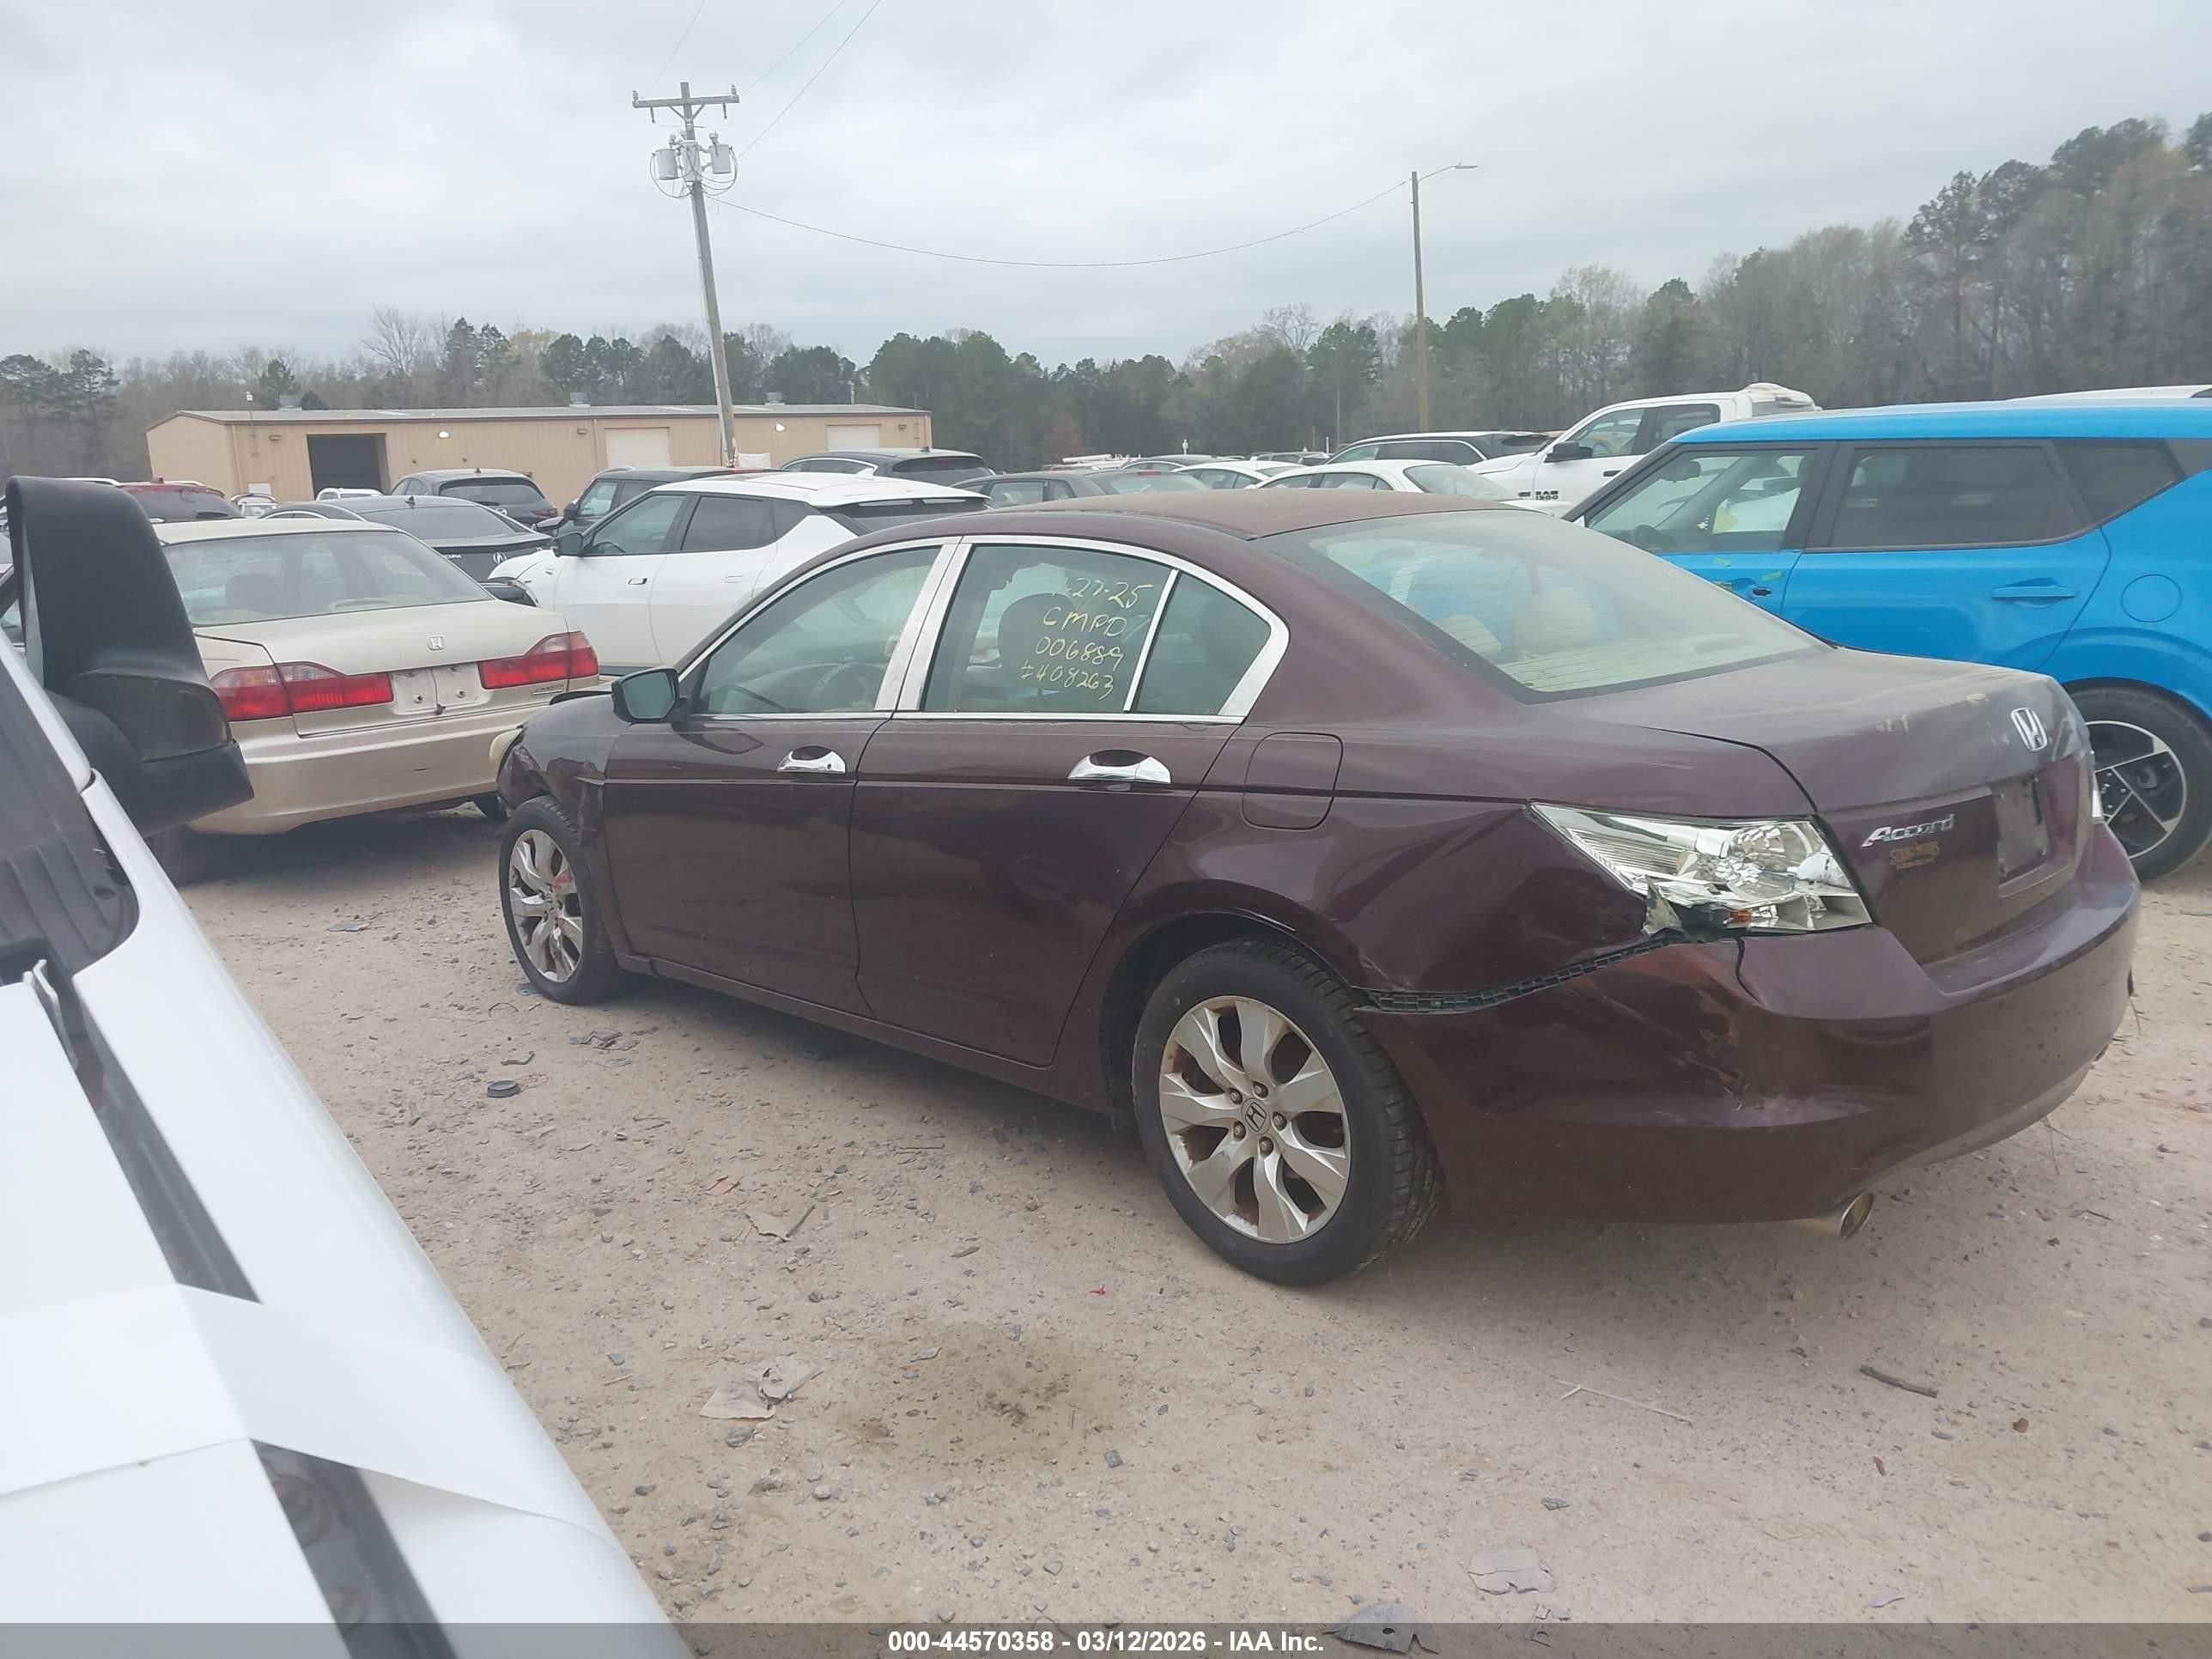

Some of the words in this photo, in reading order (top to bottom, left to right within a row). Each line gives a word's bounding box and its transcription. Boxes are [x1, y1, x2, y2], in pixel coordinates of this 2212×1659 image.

[1042, 606, 1127, 637] CMPD
[1035, 635, 1124, 672] 006889
[1020, 659, 1115, 701] #408263
[1861, 813, 1955, 848] Accord
